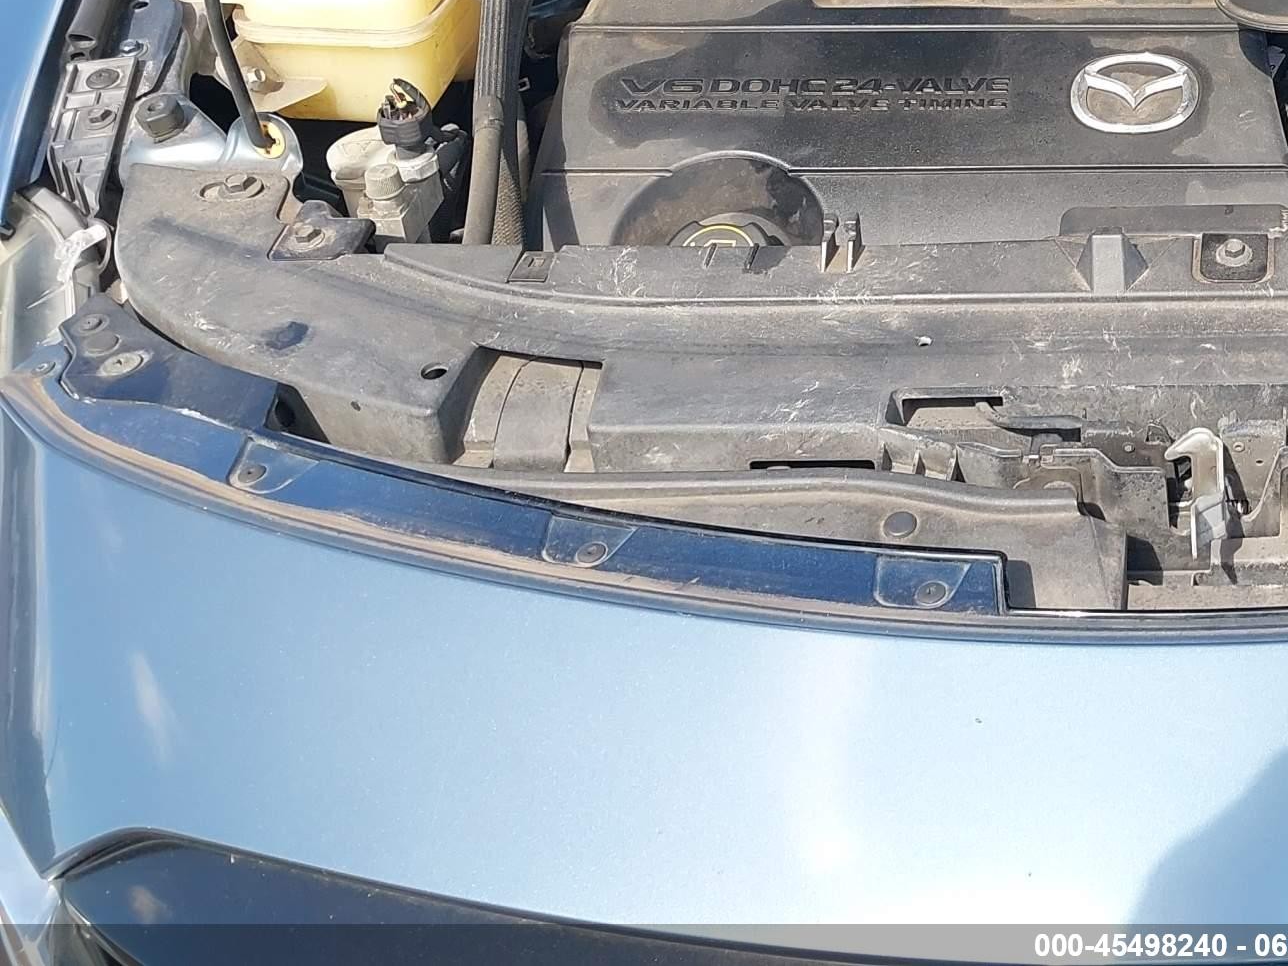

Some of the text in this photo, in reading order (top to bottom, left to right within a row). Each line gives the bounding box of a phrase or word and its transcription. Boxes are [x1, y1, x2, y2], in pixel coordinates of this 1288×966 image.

[620, 77, 1011, 96] V6 DOHC 24-VALVE
[616, 97, 1008, 111] VARIABLE VALVE TIMING
